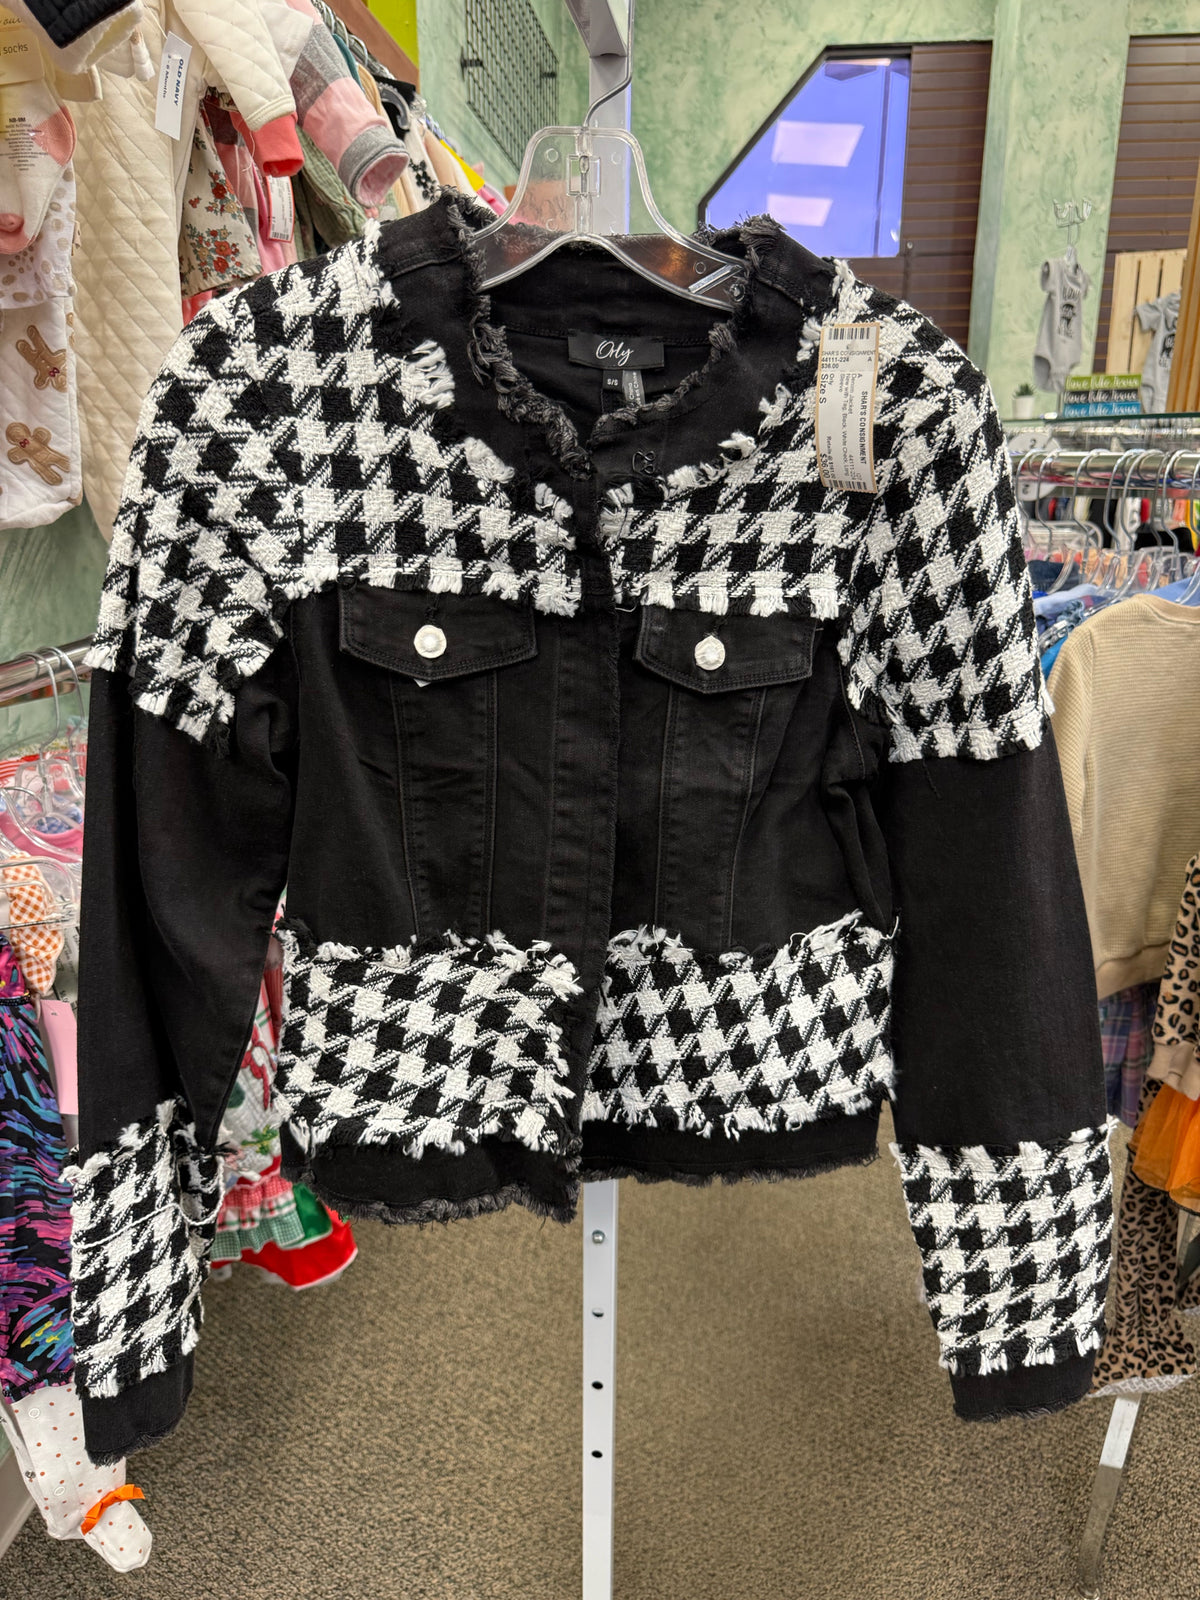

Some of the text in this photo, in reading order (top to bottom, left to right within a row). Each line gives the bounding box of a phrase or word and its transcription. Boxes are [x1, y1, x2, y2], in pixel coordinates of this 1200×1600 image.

[3, 43, 28, 54] socks
[596, 340, 634, 367] Orly
[820, 374, 828, 394] Size
[859, 391, 868, 465] SHAR'S CONSIGNMENT
[1030, 438, 1036, 448] 2
[820, 453, 830, 478] $36.00
[843, 465, 851, 476] Long
